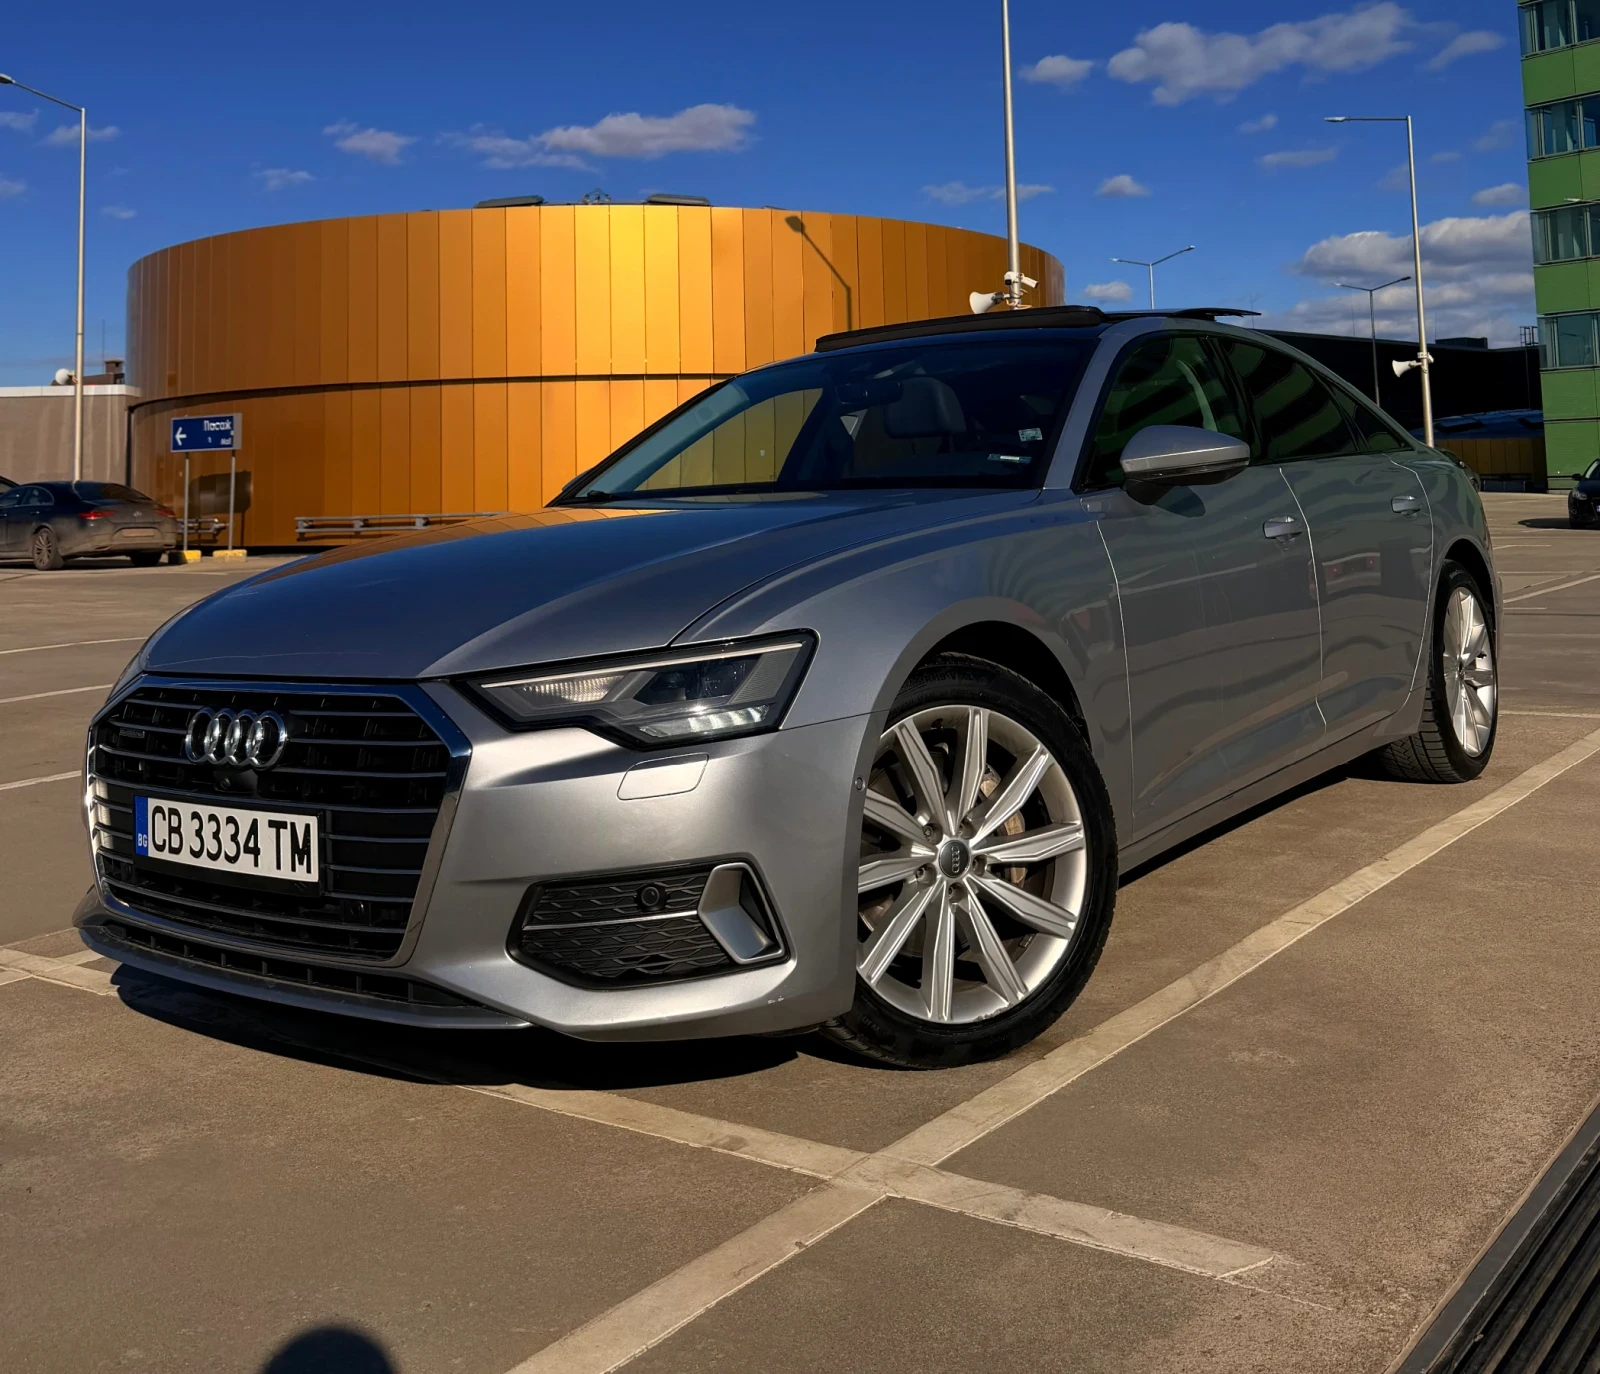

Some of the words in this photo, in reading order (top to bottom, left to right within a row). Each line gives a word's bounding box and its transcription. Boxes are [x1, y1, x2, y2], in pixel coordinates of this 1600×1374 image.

[138, 833, 148, 847] BG
[151, 805, 183, 855] CB
[189, 811, 260, 867] 3334
[268, 819, 312, 874] TM
